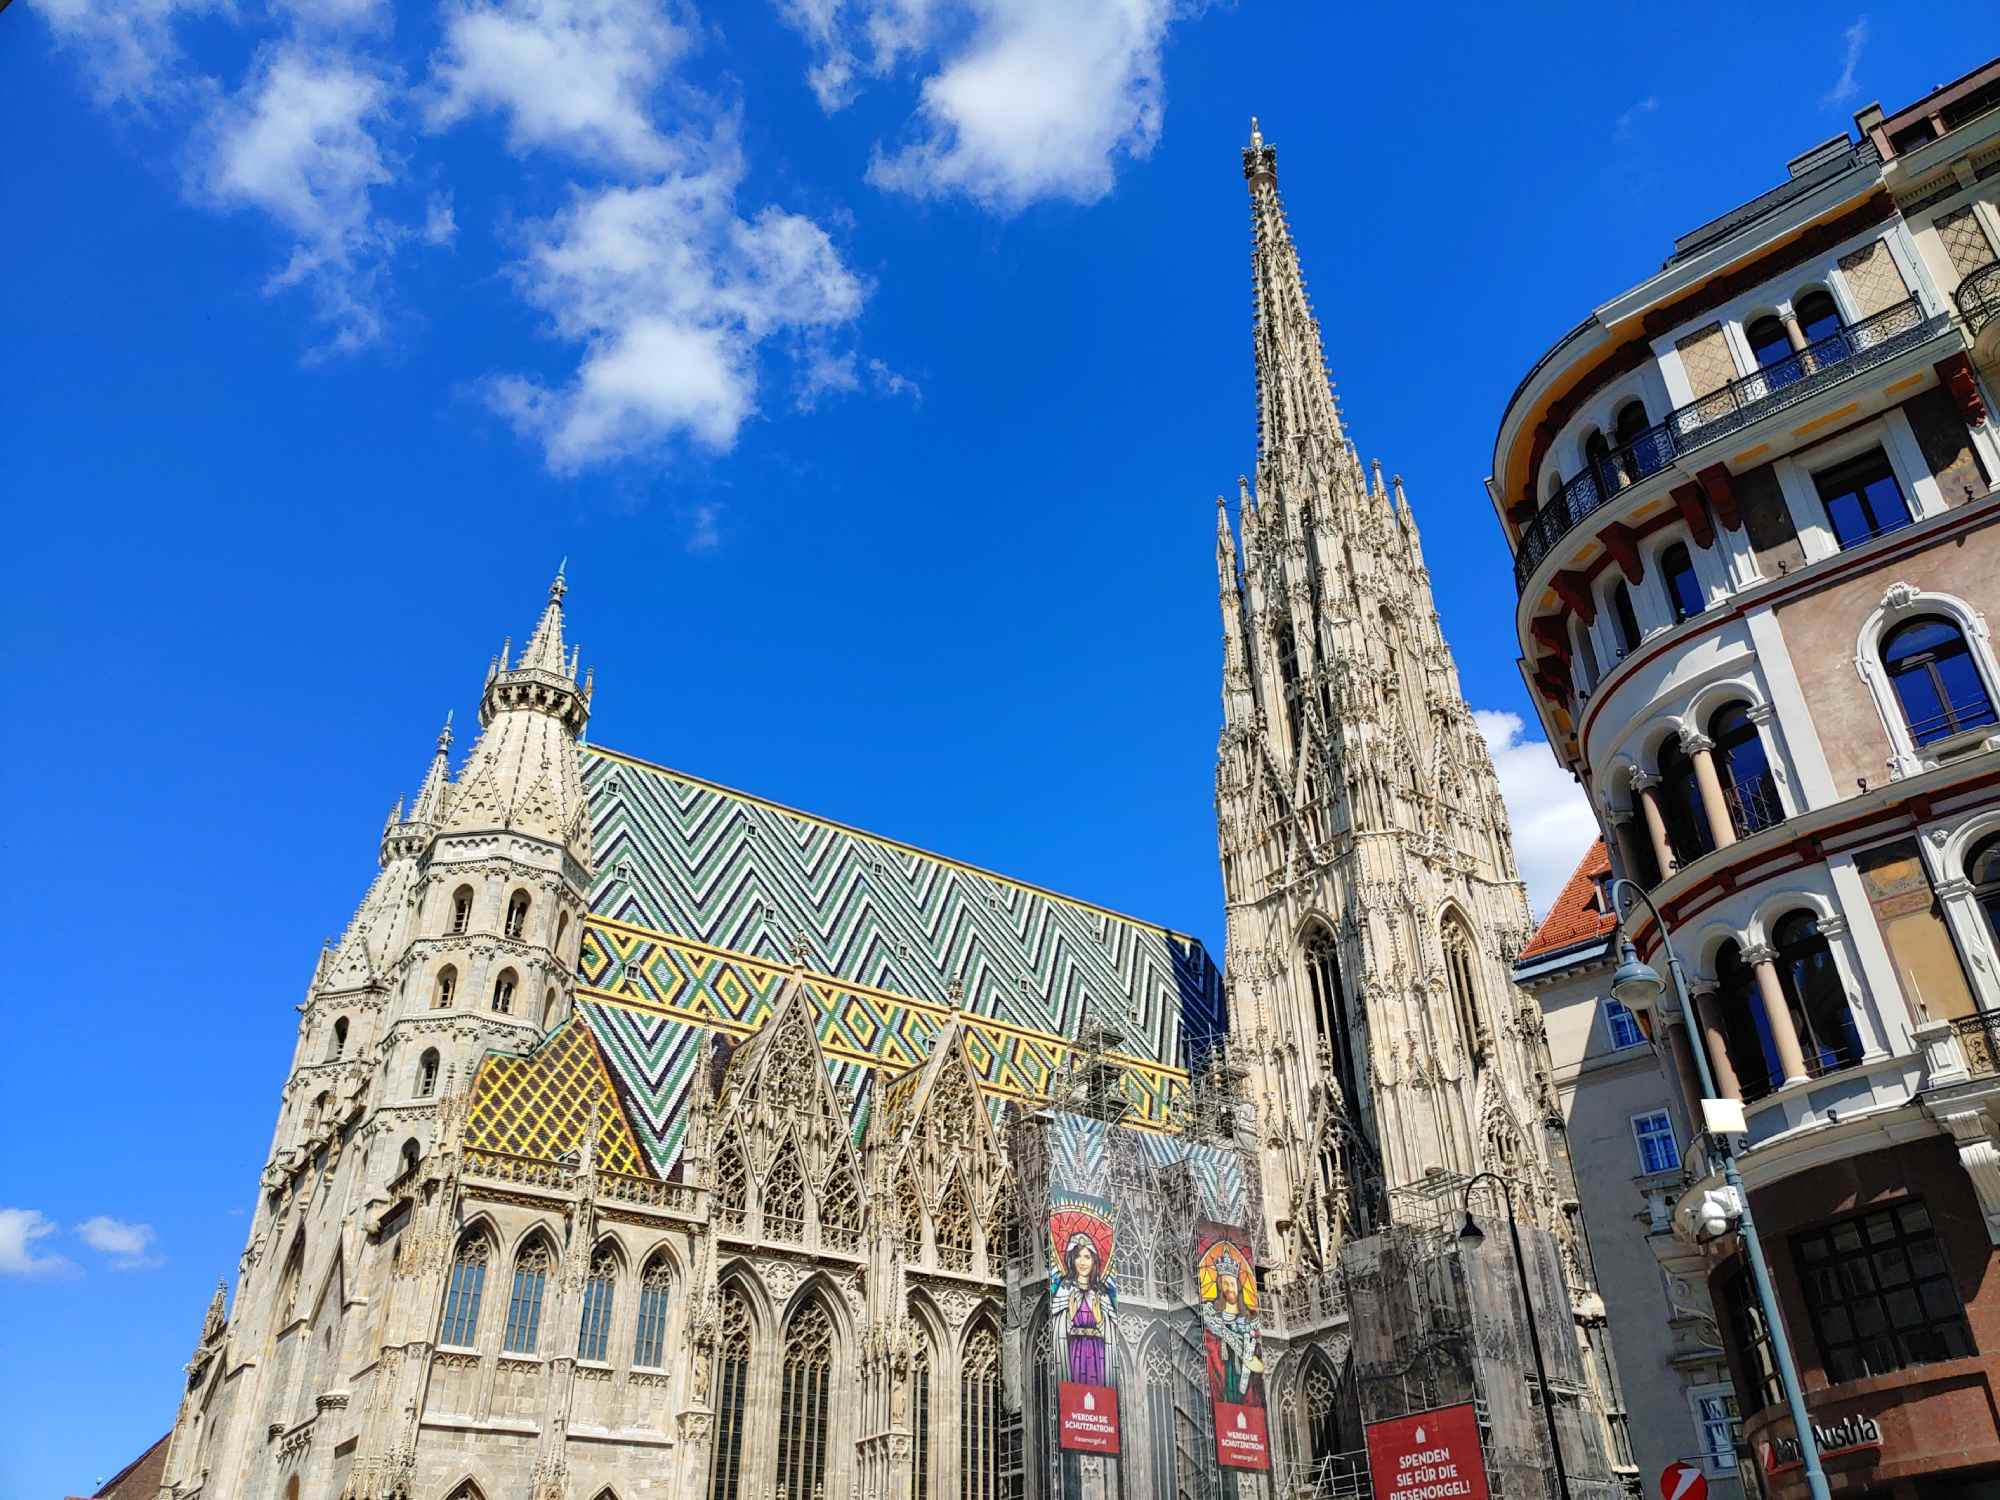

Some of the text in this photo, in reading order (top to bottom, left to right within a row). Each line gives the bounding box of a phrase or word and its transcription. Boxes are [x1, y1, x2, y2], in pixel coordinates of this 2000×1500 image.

[1071, 1412, 1108, 1424] WERDEN SIE
[1226, 1430, 1250, 1441] WERDEN
[1813, 1415, 1880, 1451] Austria
[1399, 1447, 1450, 1469] SPENDEN
[1396, 1464, 1458, 1487] SIE FÜR DIE
[1390, 1480, 1472, 1500] RIESENORGEL!
